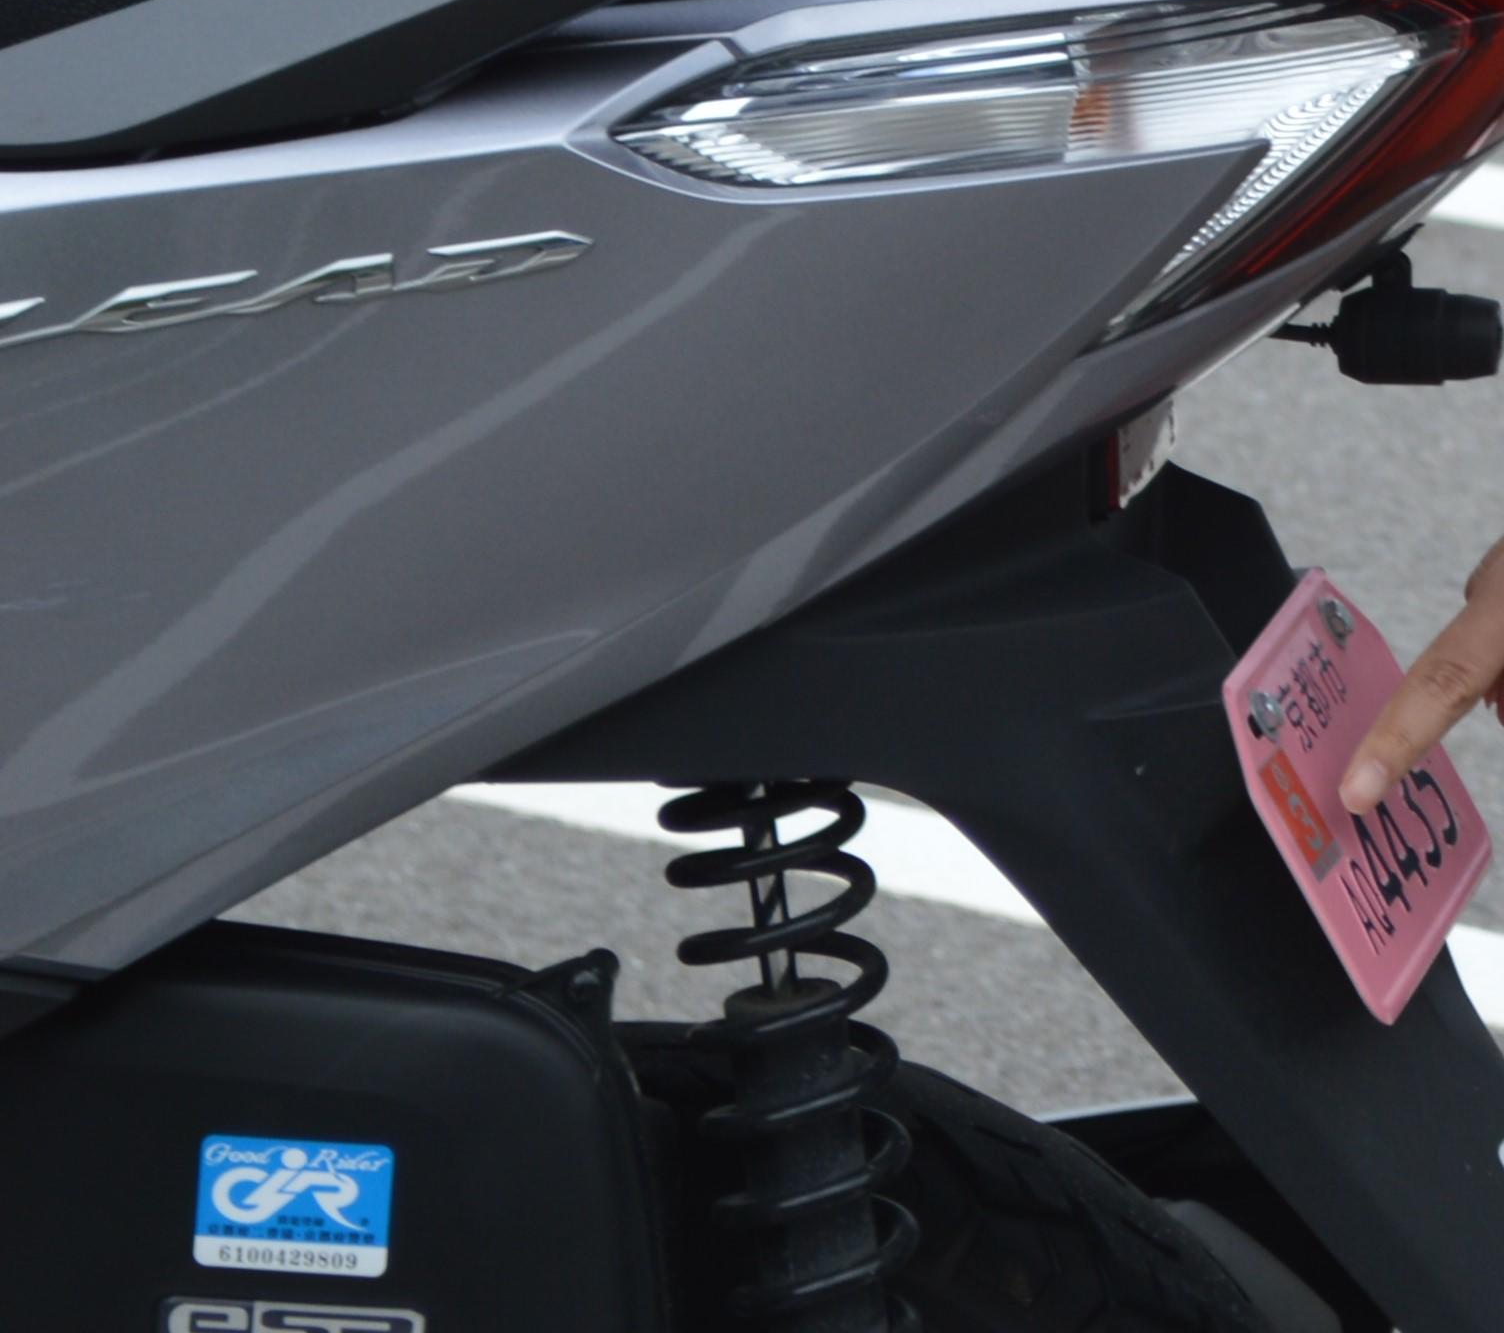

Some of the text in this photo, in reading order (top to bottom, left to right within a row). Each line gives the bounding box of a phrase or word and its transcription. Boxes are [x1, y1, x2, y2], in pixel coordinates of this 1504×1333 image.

[1277, 640, 1346, 753] 京都市
[205, 1143, 287, 1165] Good
[218, 1243, 358, 1270] 6100429809
